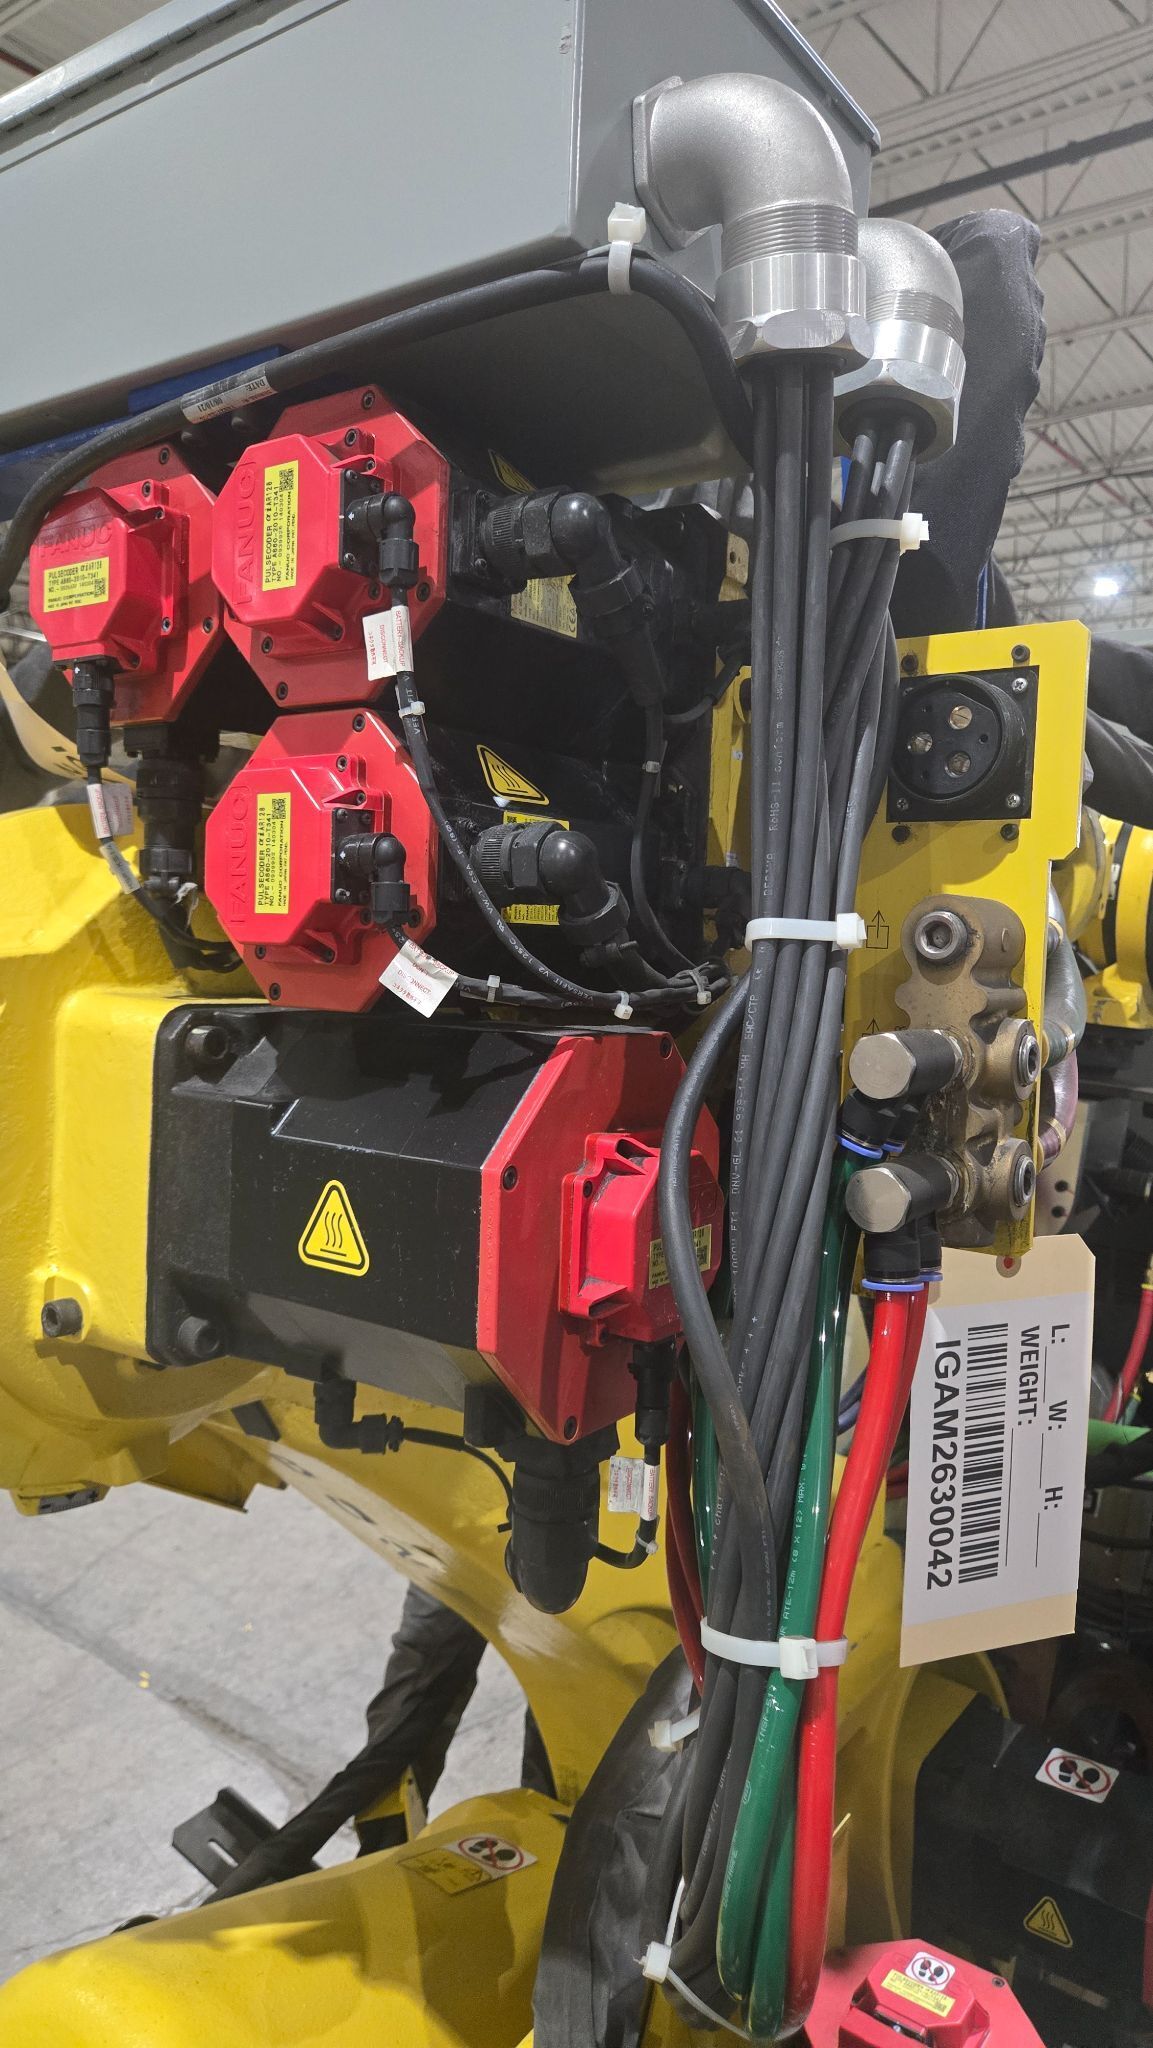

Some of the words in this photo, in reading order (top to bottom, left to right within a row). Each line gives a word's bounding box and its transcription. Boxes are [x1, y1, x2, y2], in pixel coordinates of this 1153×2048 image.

[39, 521, 114, 559] FANUC
[235, 461, 259, 606] FANUC
[228, 783, 253, 928] FANUC
[396, 969, 431, 995] DISCONNECT
[731, 1151, 743, 1196] DNV-GL
[744, 994, 759, 1040] EAC/CTP
[1050, 1323, 1071, 1345] L:
[1016, 1324, 1040, 1427] WEIGHT:
[1047, 1400, 1069, 1431] W:
[926, 1339, 962, 1591] IGAM2630042
[1043, 1486, 1064, 1511] H:
[783, 1570, 797, 1620] ATE-12m
